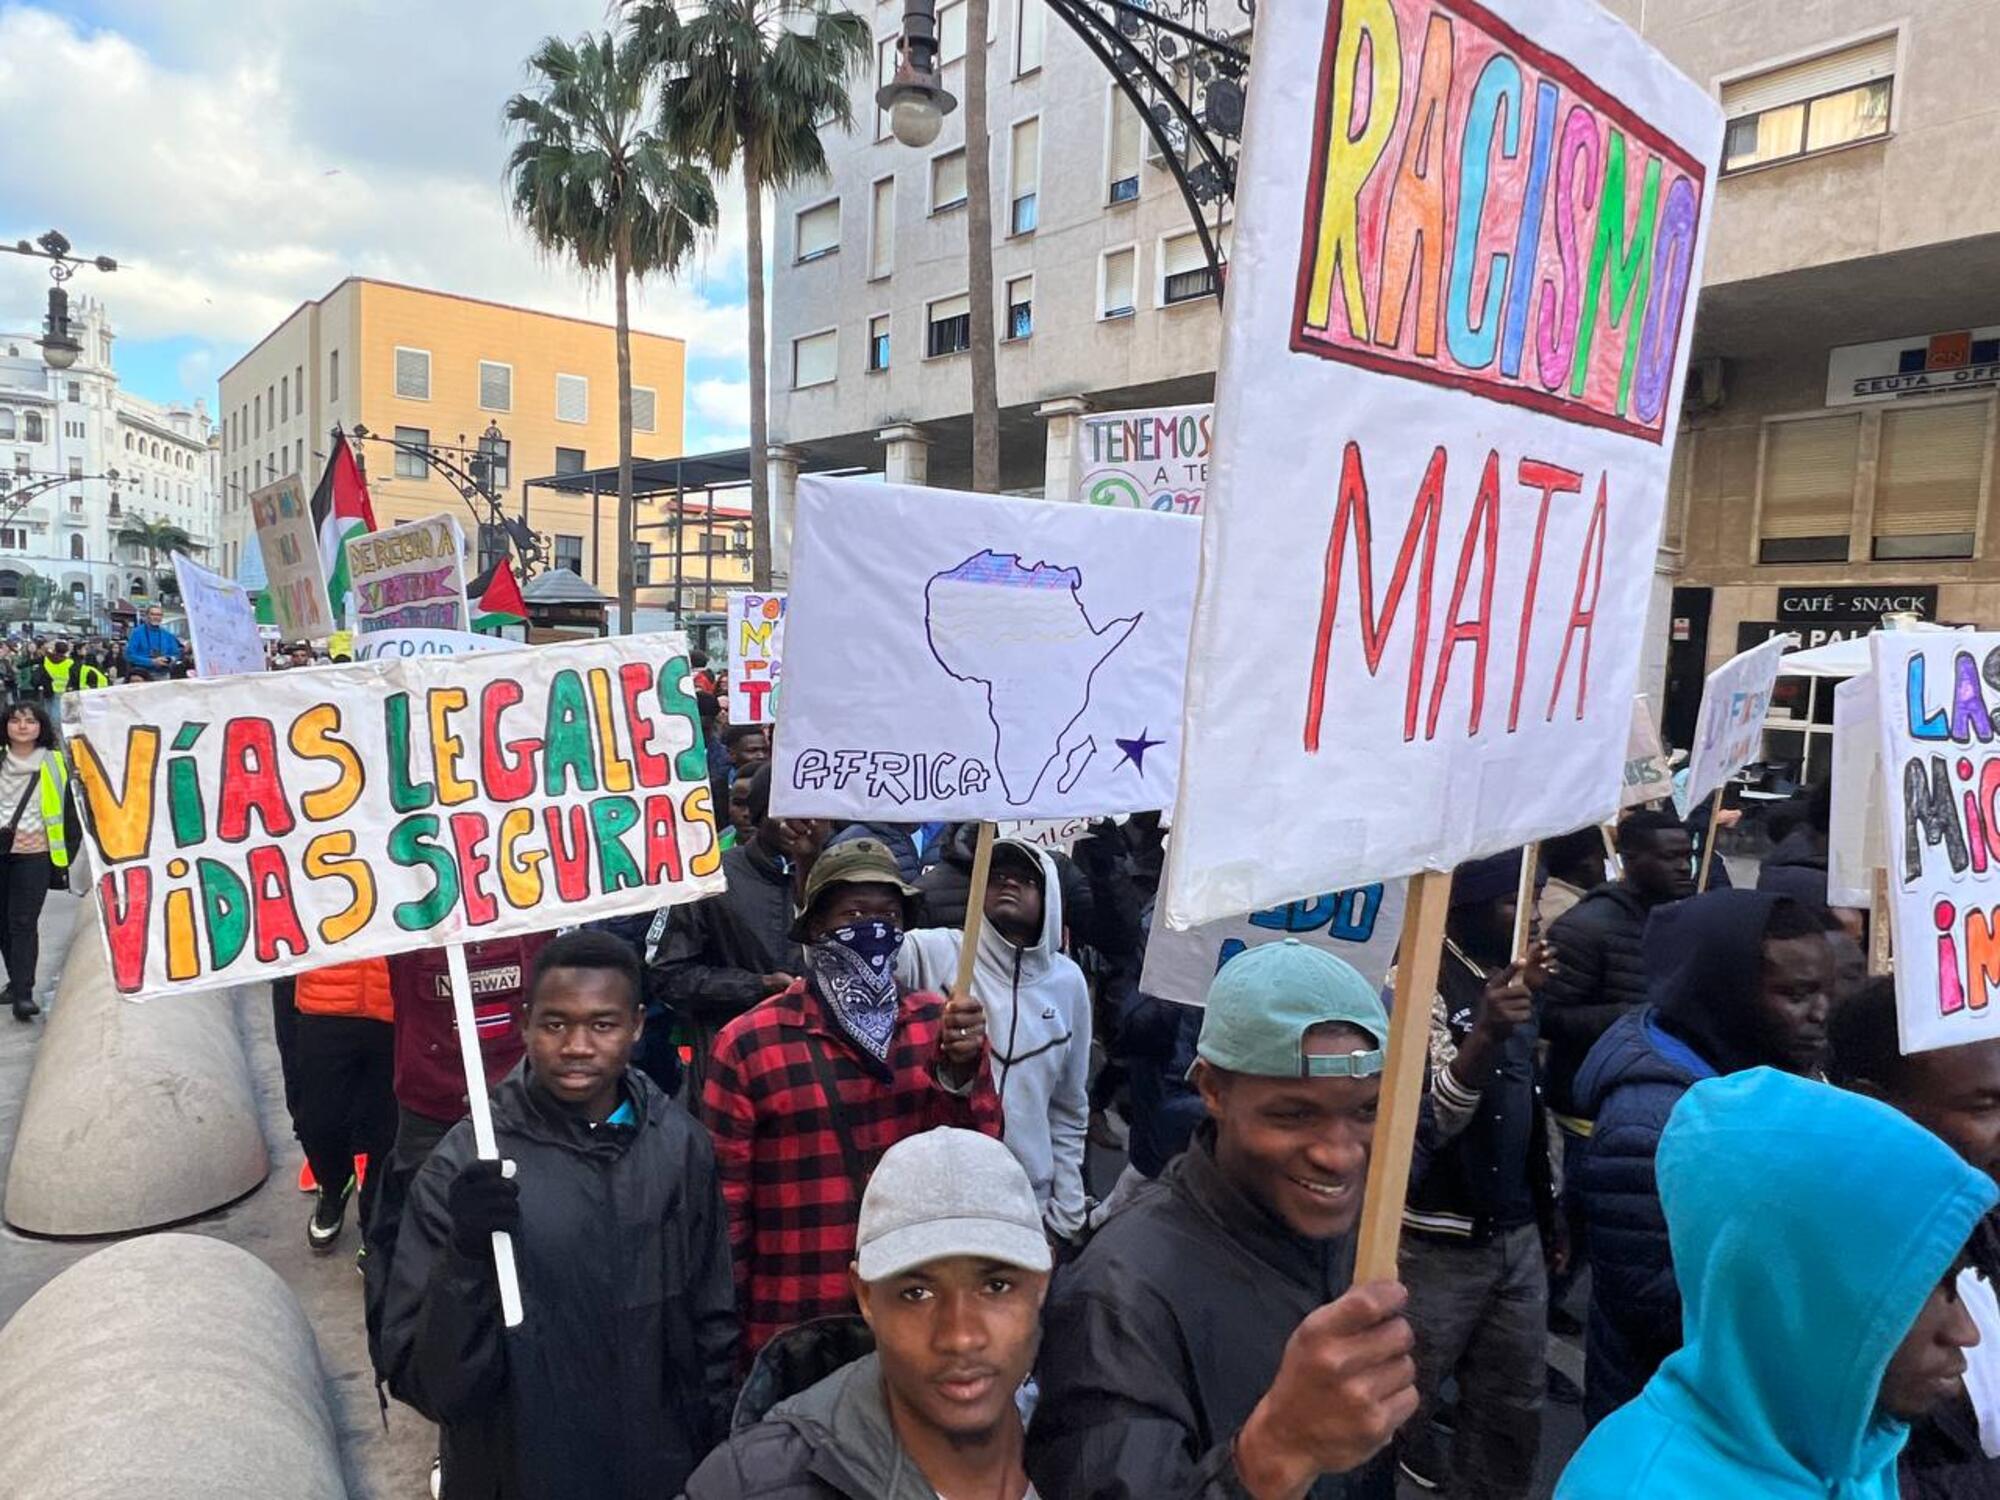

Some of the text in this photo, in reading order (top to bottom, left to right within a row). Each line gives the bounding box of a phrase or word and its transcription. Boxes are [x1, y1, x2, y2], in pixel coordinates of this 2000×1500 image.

[1306, 0, 1697, 424] RACISMO
[1854, 373, 1930, 394] CEUTA
[1086, 414, 1211, 464] TENEMOS
[1154, 466, 1169, 485] A
[1303, 440, 1608, 754] MATA
[1783, 595, 1835, 613] CAFÉ
[1850, 596, 1926, 613] SNACK
[384, 655, 708, 813] LEGALES
[793, 748, 991, 804] AFRICA
[387, 786, 721, 932] SEGURAS
[438, 975, 517, 995] NRWAY
